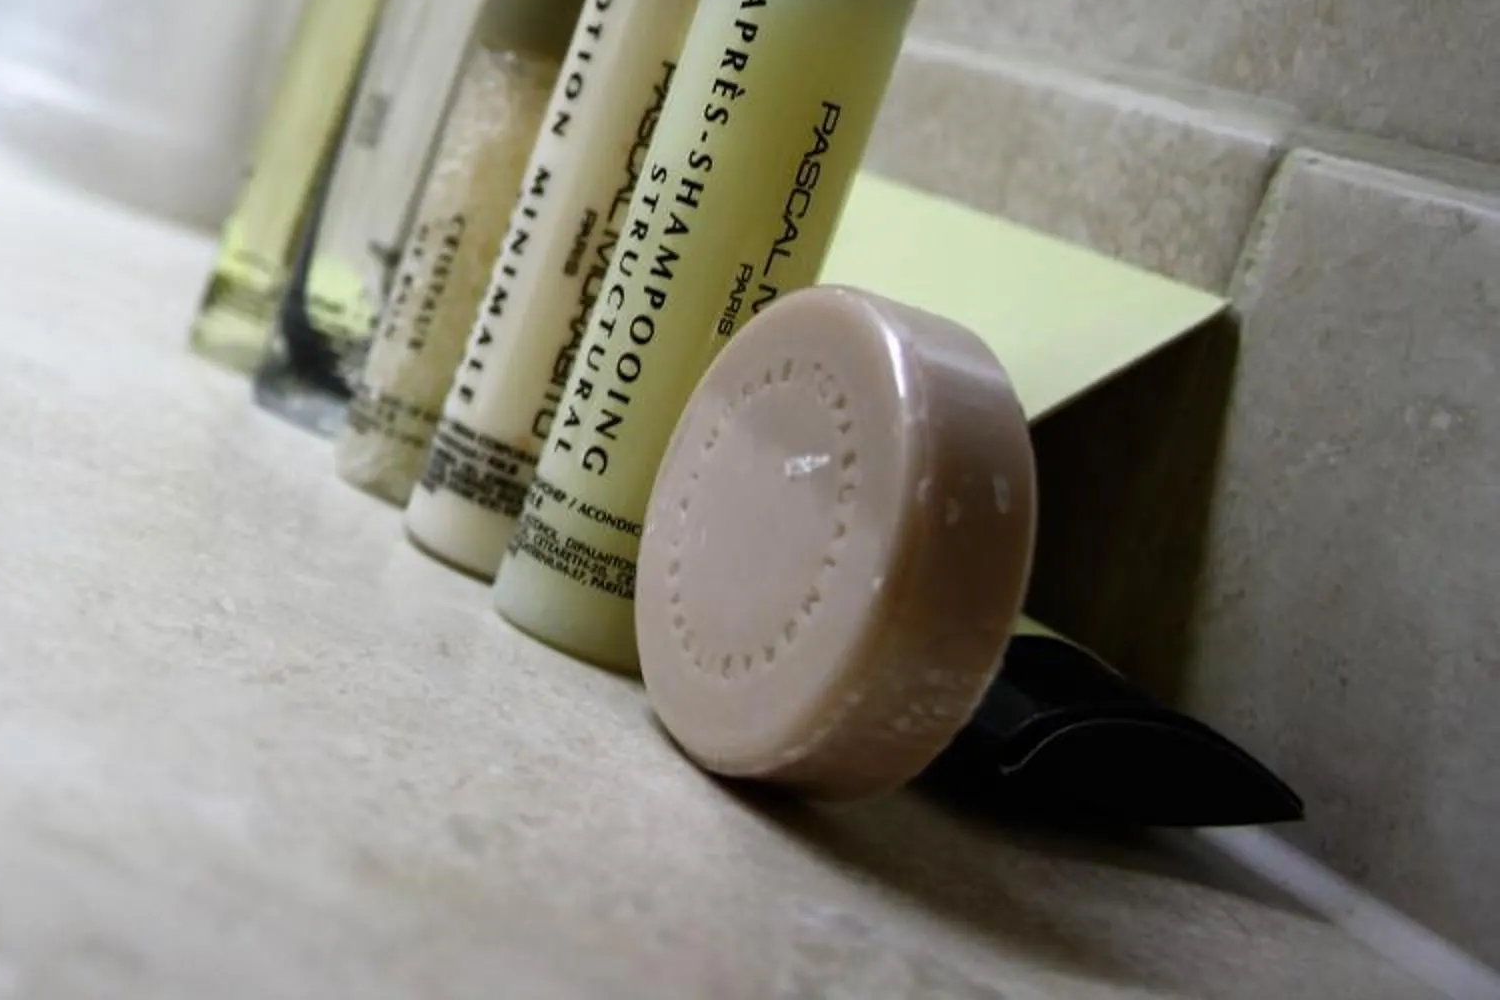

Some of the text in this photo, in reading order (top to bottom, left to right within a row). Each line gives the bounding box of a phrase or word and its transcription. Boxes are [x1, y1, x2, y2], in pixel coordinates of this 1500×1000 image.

[563, 208, 598, 277] PARIS
[764, 100, 842, 278] PASCAL
[458, 166, 552, 404] MINIMALE
[554, 164, 668, 454] STRUCTURAL
[717, 263, 755, 337] PARIS
